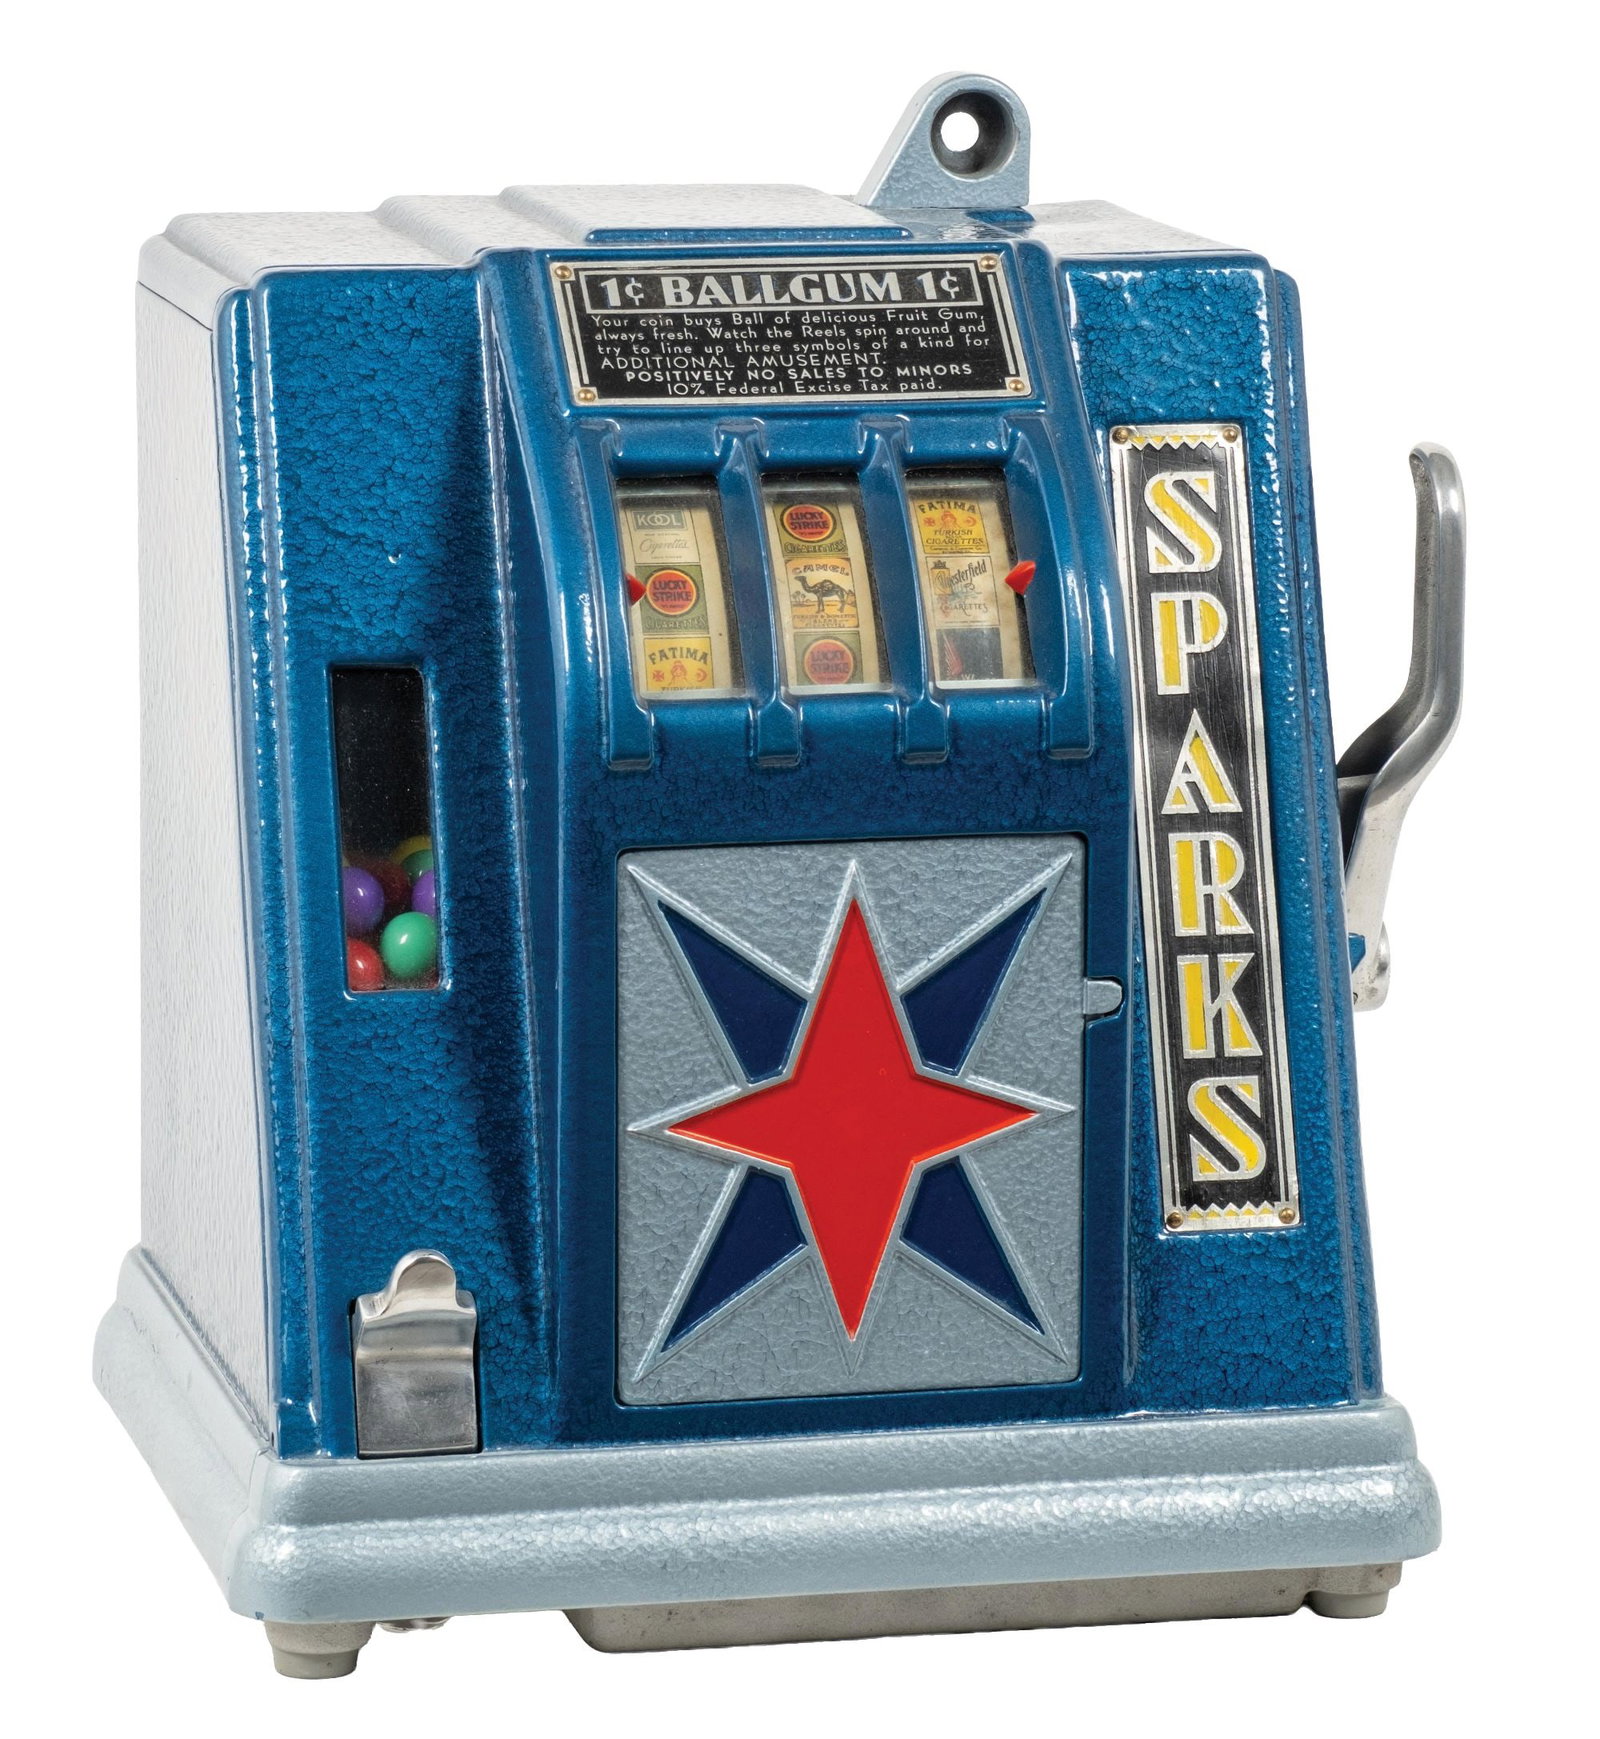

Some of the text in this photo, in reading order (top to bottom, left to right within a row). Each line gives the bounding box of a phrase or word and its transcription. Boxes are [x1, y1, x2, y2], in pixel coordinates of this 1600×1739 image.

[601, 271, 960, 307] 1¢ BALLGUM 1¢
[591, 315, 629, 327] Your
[640, 315, 674, 327] coin
[684, 314, 722, 327] buys
[732, 313, 764, 325] Ball
[774, 312, 791, 325] of
[802, 311, 876, 324] delicious
[887, 309, 928, 322] Fruit
[595, 320, 986, 342] always fresh. Watch the Reels spin around and
[597, 335, 990, 357] try to line up three symbols of a kind for
[601, 352, 887, 370] ADDITIONAL AMUSEMENT.
[626, 364, 972, 383] POSITIVELY NO SALES TO MINORS
[668, 378, 942, 395] 10% Federal Excise Tax paid.
[918, 500, 977, 514] FATIMA
[637, 513, 682, 526] KOOL
[790, 511, 824, 521] LUCKY
[790, 520, 830, 530] STRIKE
[792, 563, 849, 576] CAMEL
[653, 579, 687, 591] LUCKY
[653, 590, 692, 602] STRIKE
[648, 647, 709, 665] FATIMA
[811, 650, 845, 661] LUCKY
[811, 662, 849, 673] STRIKE
[1145, 470, 1267, 1182] SPARKS
